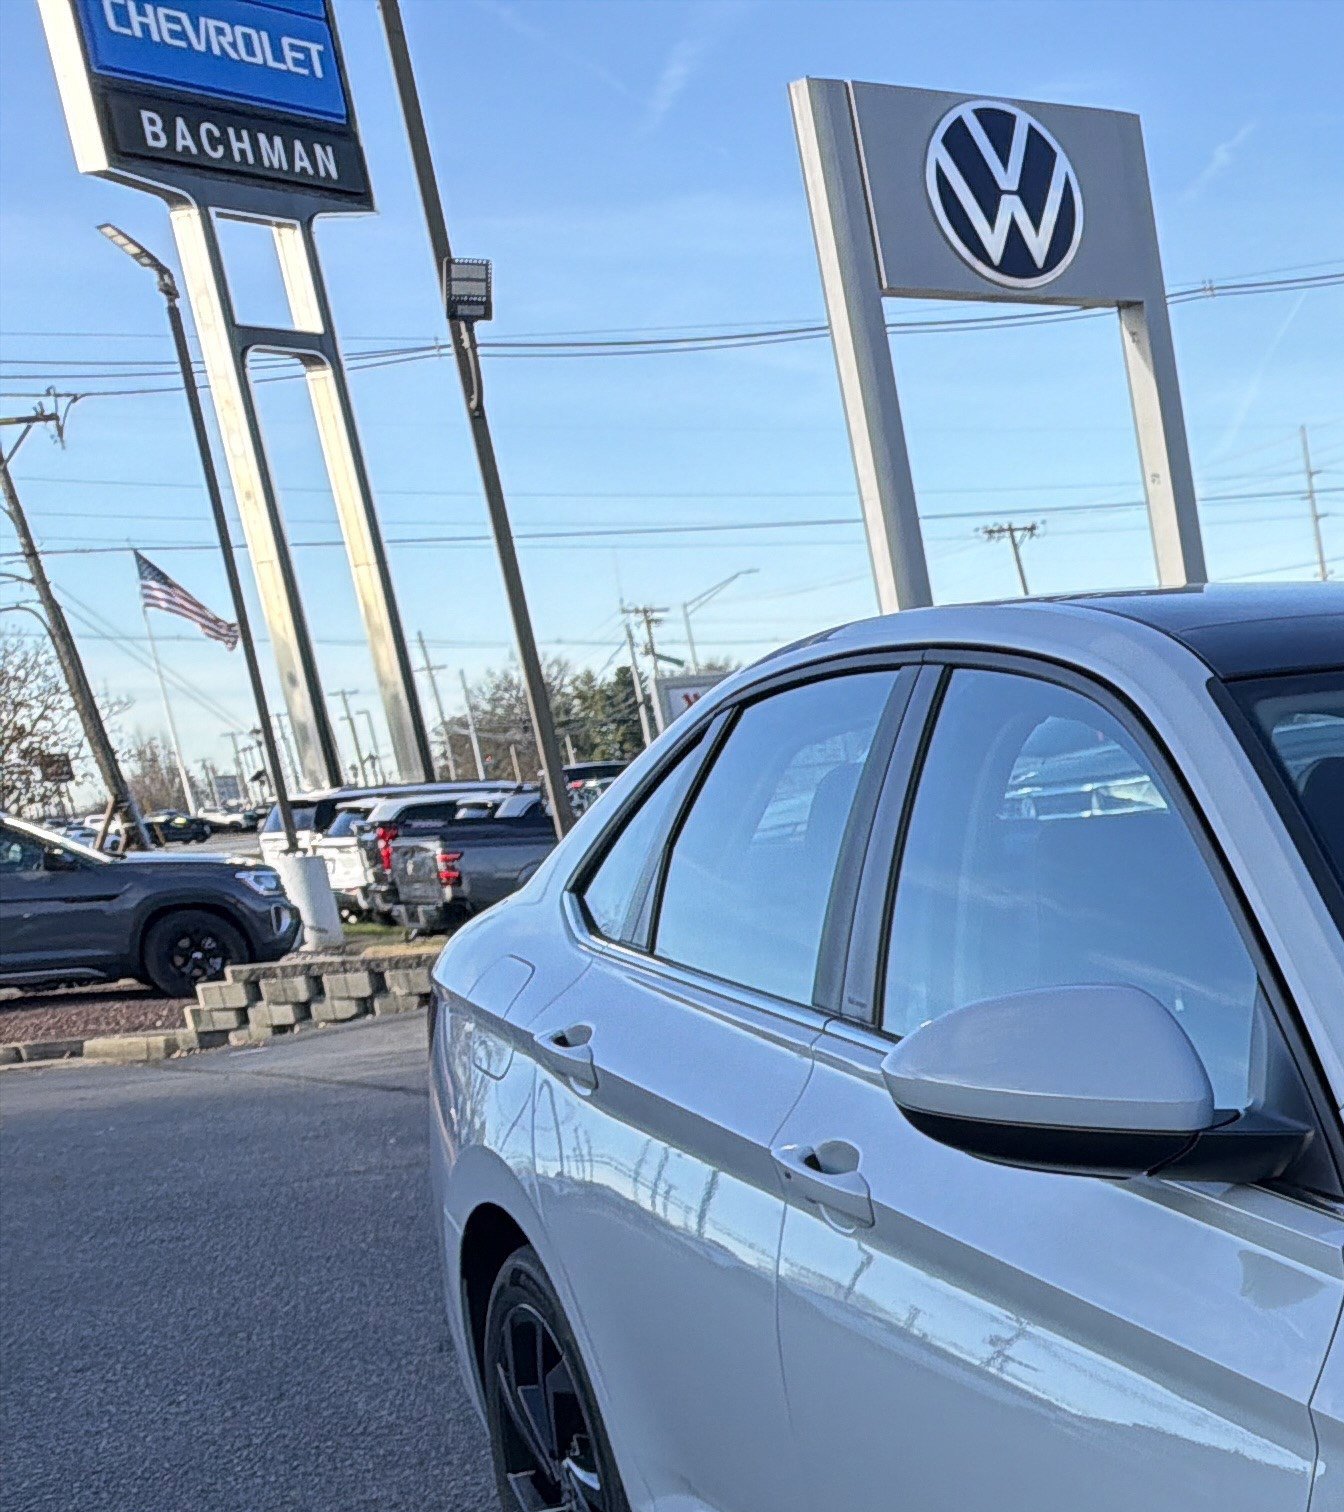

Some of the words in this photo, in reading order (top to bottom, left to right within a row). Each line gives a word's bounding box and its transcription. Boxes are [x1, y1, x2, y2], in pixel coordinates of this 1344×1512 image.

[103, 0, 324, 79] CHEVROLET
[140, 109, 339, 180] BACHMAN
[928, 101, 1080, 283] VW
